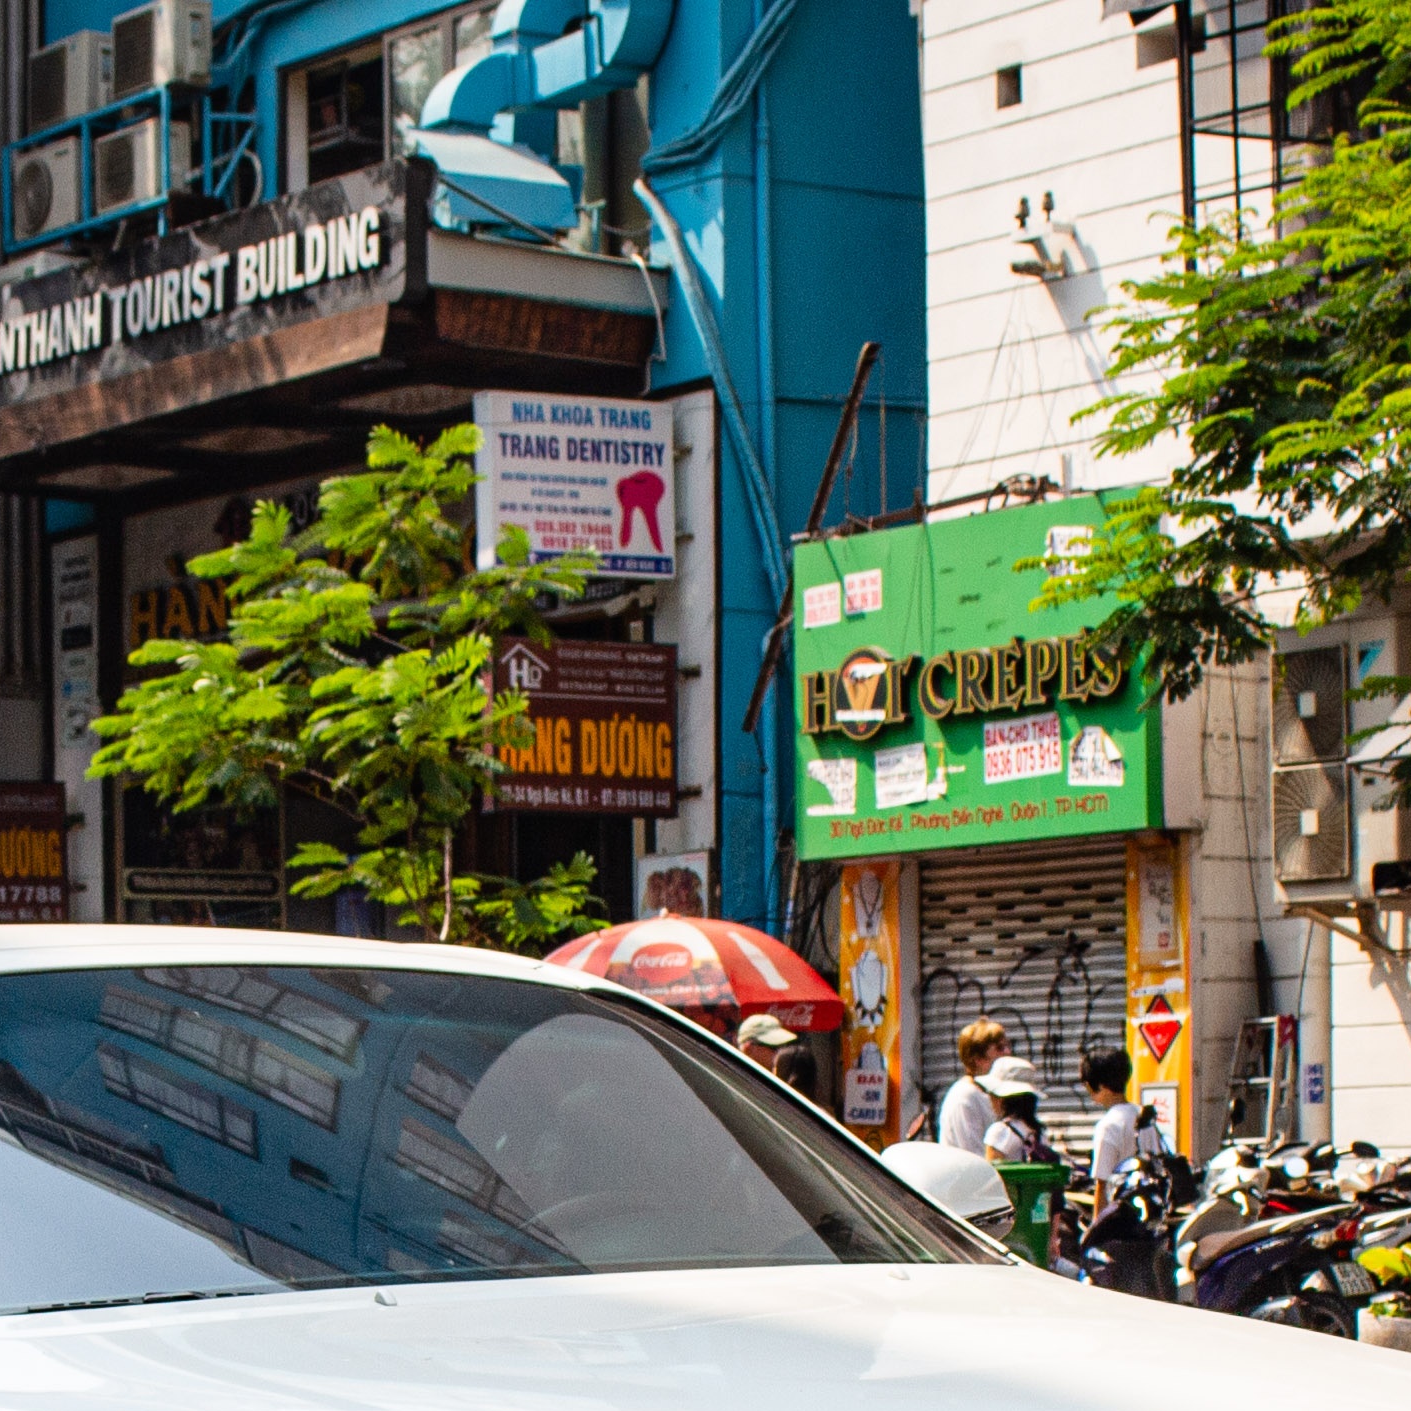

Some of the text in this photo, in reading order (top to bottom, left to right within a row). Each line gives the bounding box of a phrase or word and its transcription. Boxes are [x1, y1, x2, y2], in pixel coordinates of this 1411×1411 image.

[110, 252, 232, 342] TOURIST
[236, 206, 381, 303] BUILDING
[512, 402, 653, 431] NHA KHOA TRANG
[498, 432, 666, 467] TRANG DENTISTRY
[579, 711, 673, 779] DƯƠNG
